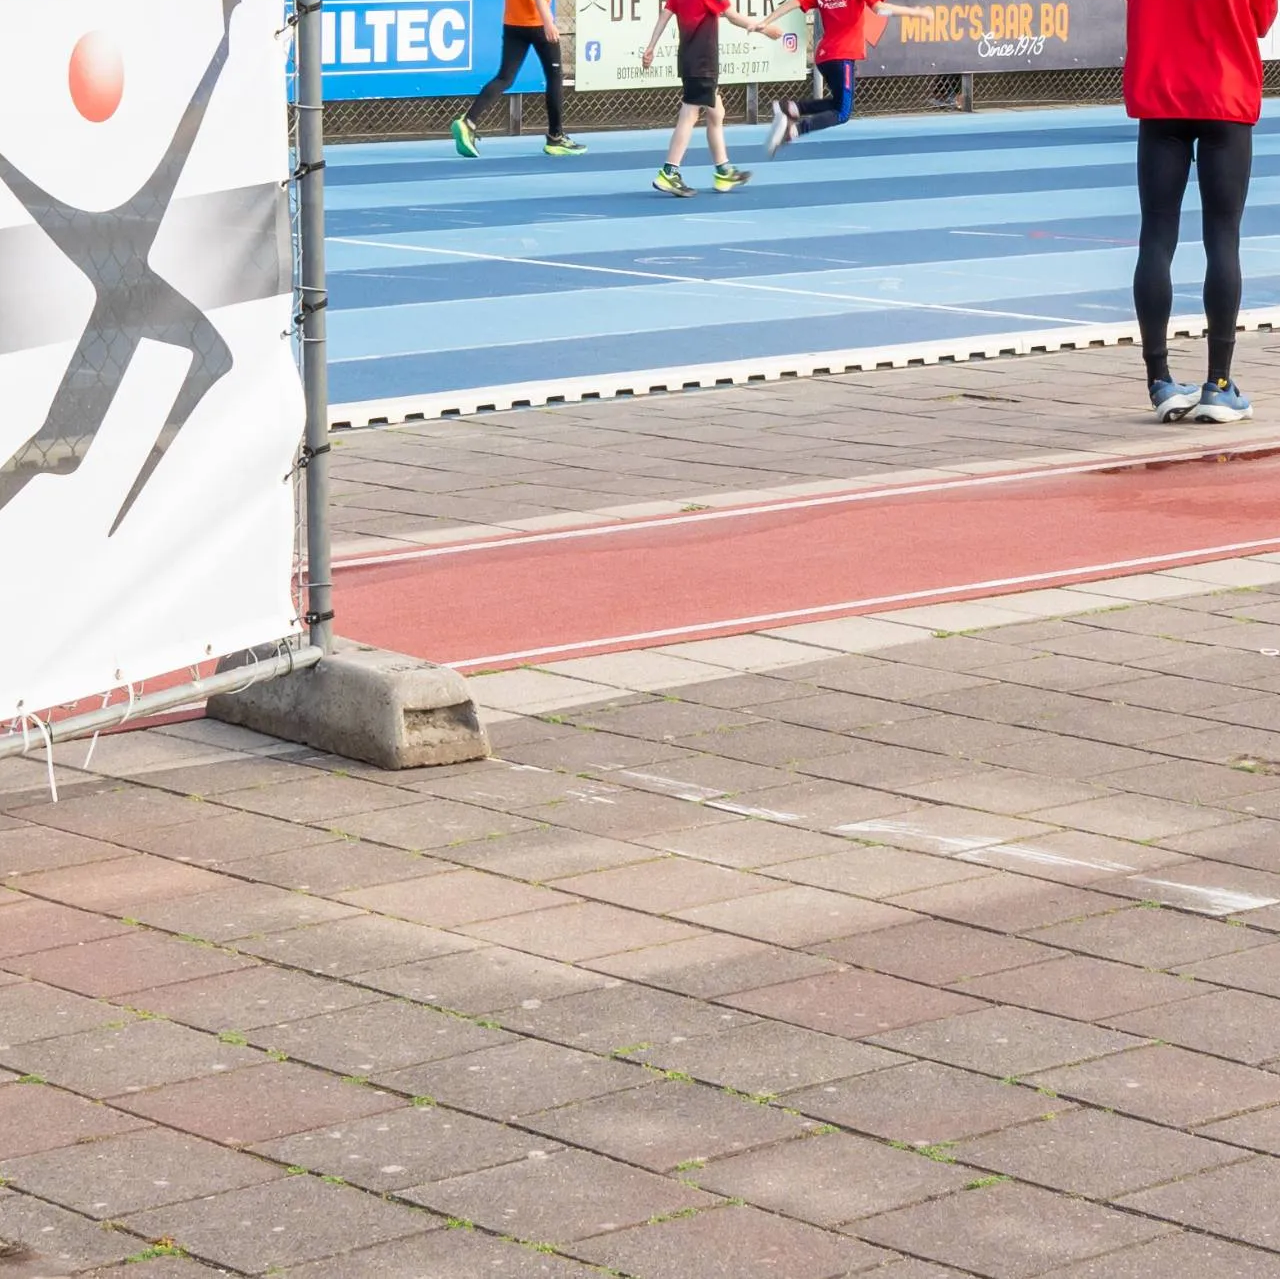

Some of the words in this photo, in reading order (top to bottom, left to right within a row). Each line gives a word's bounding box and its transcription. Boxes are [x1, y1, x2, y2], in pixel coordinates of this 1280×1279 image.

[287, 8, 466, 65] ILTEC
[900, 3, 984, 43] MARC'S
[989, 3, 1032, 39] BAR
[1040, 2, 1069, 43] BQ
[978, 32, 1015, 58] Since
[1015, 35, 1046, 57] 1973
